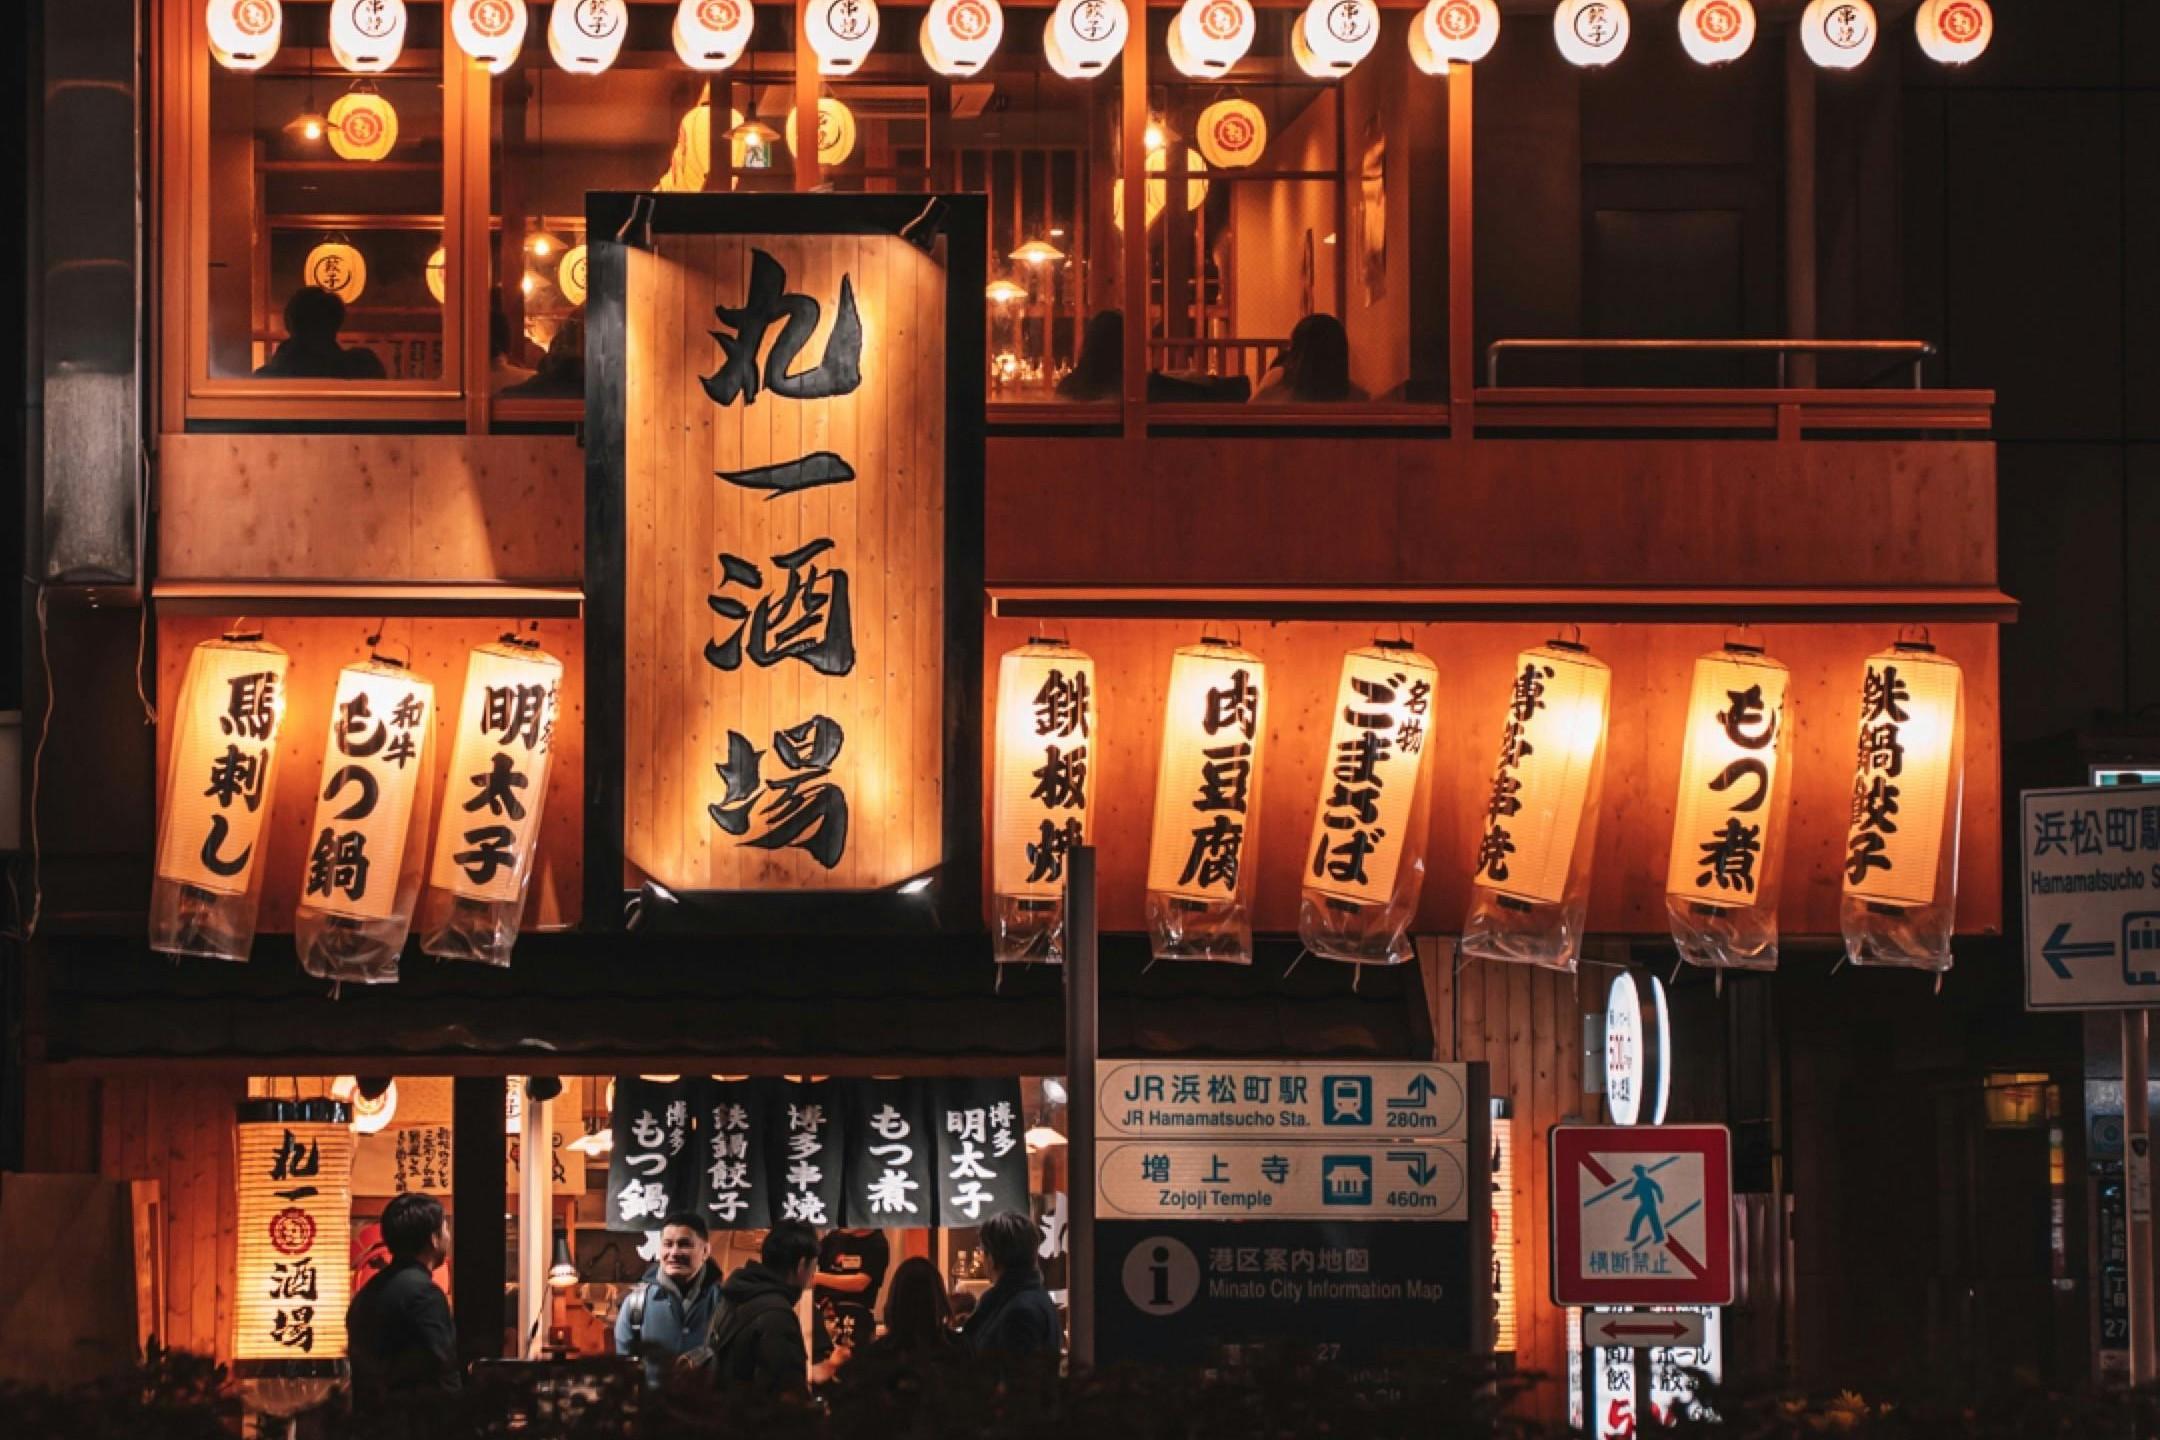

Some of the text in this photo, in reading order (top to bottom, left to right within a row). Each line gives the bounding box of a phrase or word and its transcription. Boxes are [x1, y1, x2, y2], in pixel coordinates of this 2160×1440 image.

[699, 248, 862, 869] 丸一酒場
[383, 692, 425, 769] 和牛
[1396, 679, 1431, 754] 名物
[201, 670, 279, 876] 馬刺し
[306, 692, 386, 900] もつ鍋
[453, 684, 544, 885] 明太子
[1178, 669, 1259, 891] 肉豆腐
[1312, 673, 1407, 885] ごまさば
[1696, 684, 1777, 892] もつ煮
[2032, 867, 2144, 894] Hamamatsucho
[1122, 1111, 1311, 1127] JR Hamamatsucho Sta.
[1125, 1075, 1307, 1104] JR浜松町駅
[1387, 1112, 1437, 1128] 280m
[617, 1109, 669, 1221] もつ鍋
[867, 1104, 919, 1213] もつ煮
[947, 1108, 997, 1220] 明太子
[989, 1101, 1016, 1157] 博多
[1160, 1190, 1272, 1209] Zojoji Temple
[1387, 1191, 1437, 1207] 460m
[1209, 1248, 1368, 1273] 港区案内地図
[1209, 1279, 1443, 1303] Minato City Information Map
[1589, 1250, 1672, 1274] 横断禁止
